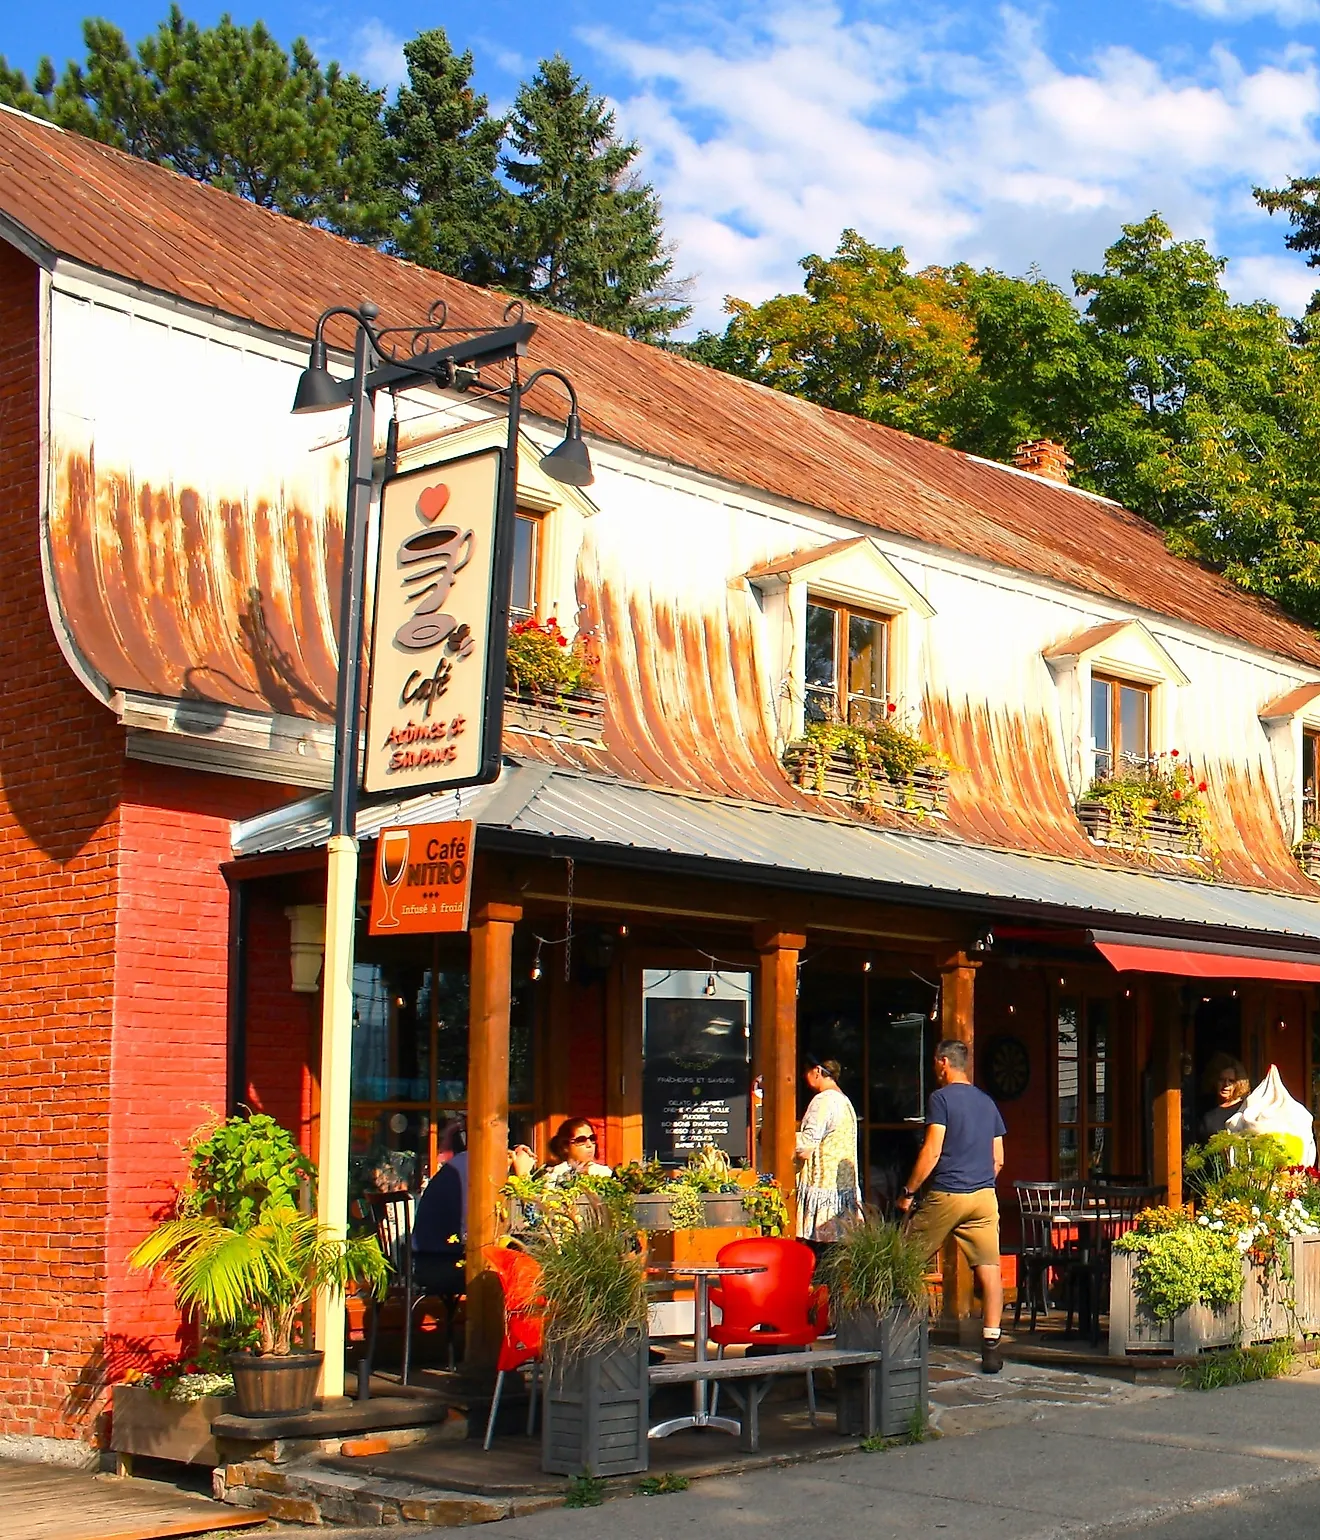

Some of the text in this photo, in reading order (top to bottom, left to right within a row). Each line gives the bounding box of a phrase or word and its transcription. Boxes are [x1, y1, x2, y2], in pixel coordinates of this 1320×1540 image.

[402, 657, 453, 717] Café
[451, 713, 466, 736] et
[427, 837, 466, 860] Café
[406, 861, 466, 887] NITRO
[401, 902, 463, 915] Infusé à froid
